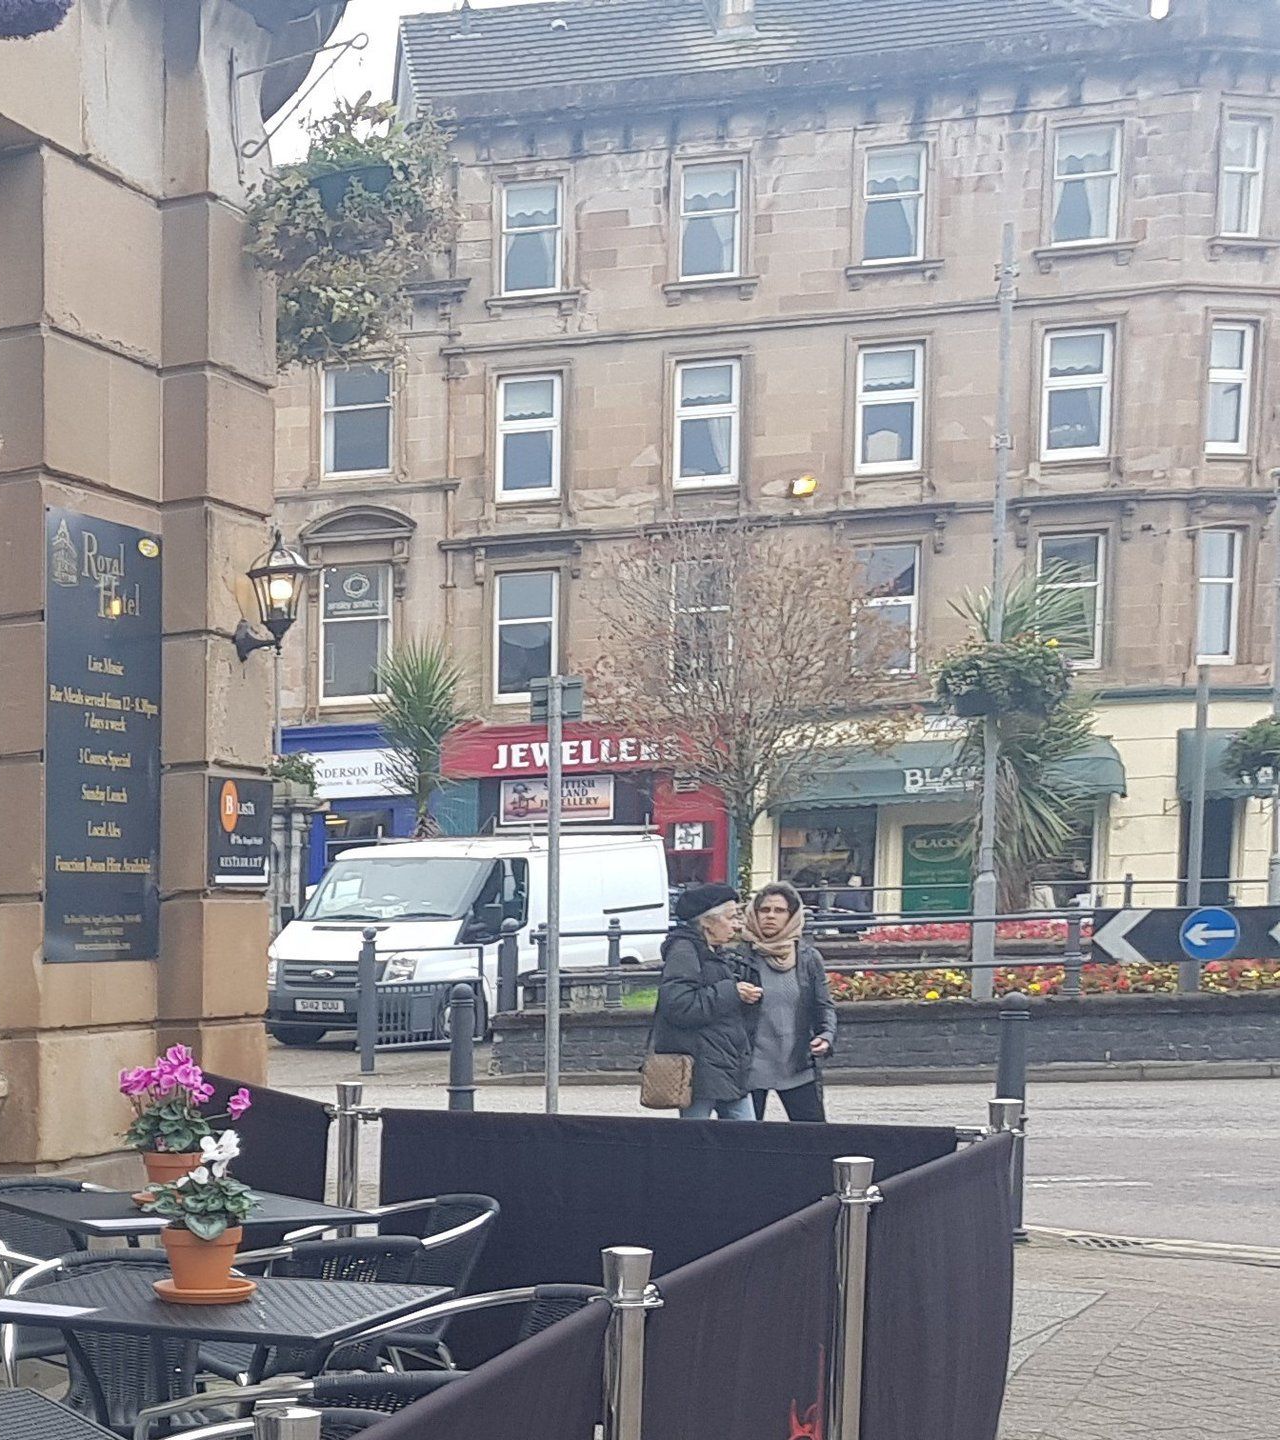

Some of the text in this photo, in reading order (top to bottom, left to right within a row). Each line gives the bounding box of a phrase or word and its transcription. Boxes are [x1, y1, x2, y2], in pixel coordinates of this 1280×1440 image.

[81, 530, 124, 580] Royal
[315, 766, 369, 778] NDERSON
[81, 783, 128, 806] Sunday Lunch
[540, 796, 600, 808] JEELLERY
[87, 820, 121, 838] Local Ales
[55, 855, 85, 872] Function
[86, 855, 105, 872] Room
